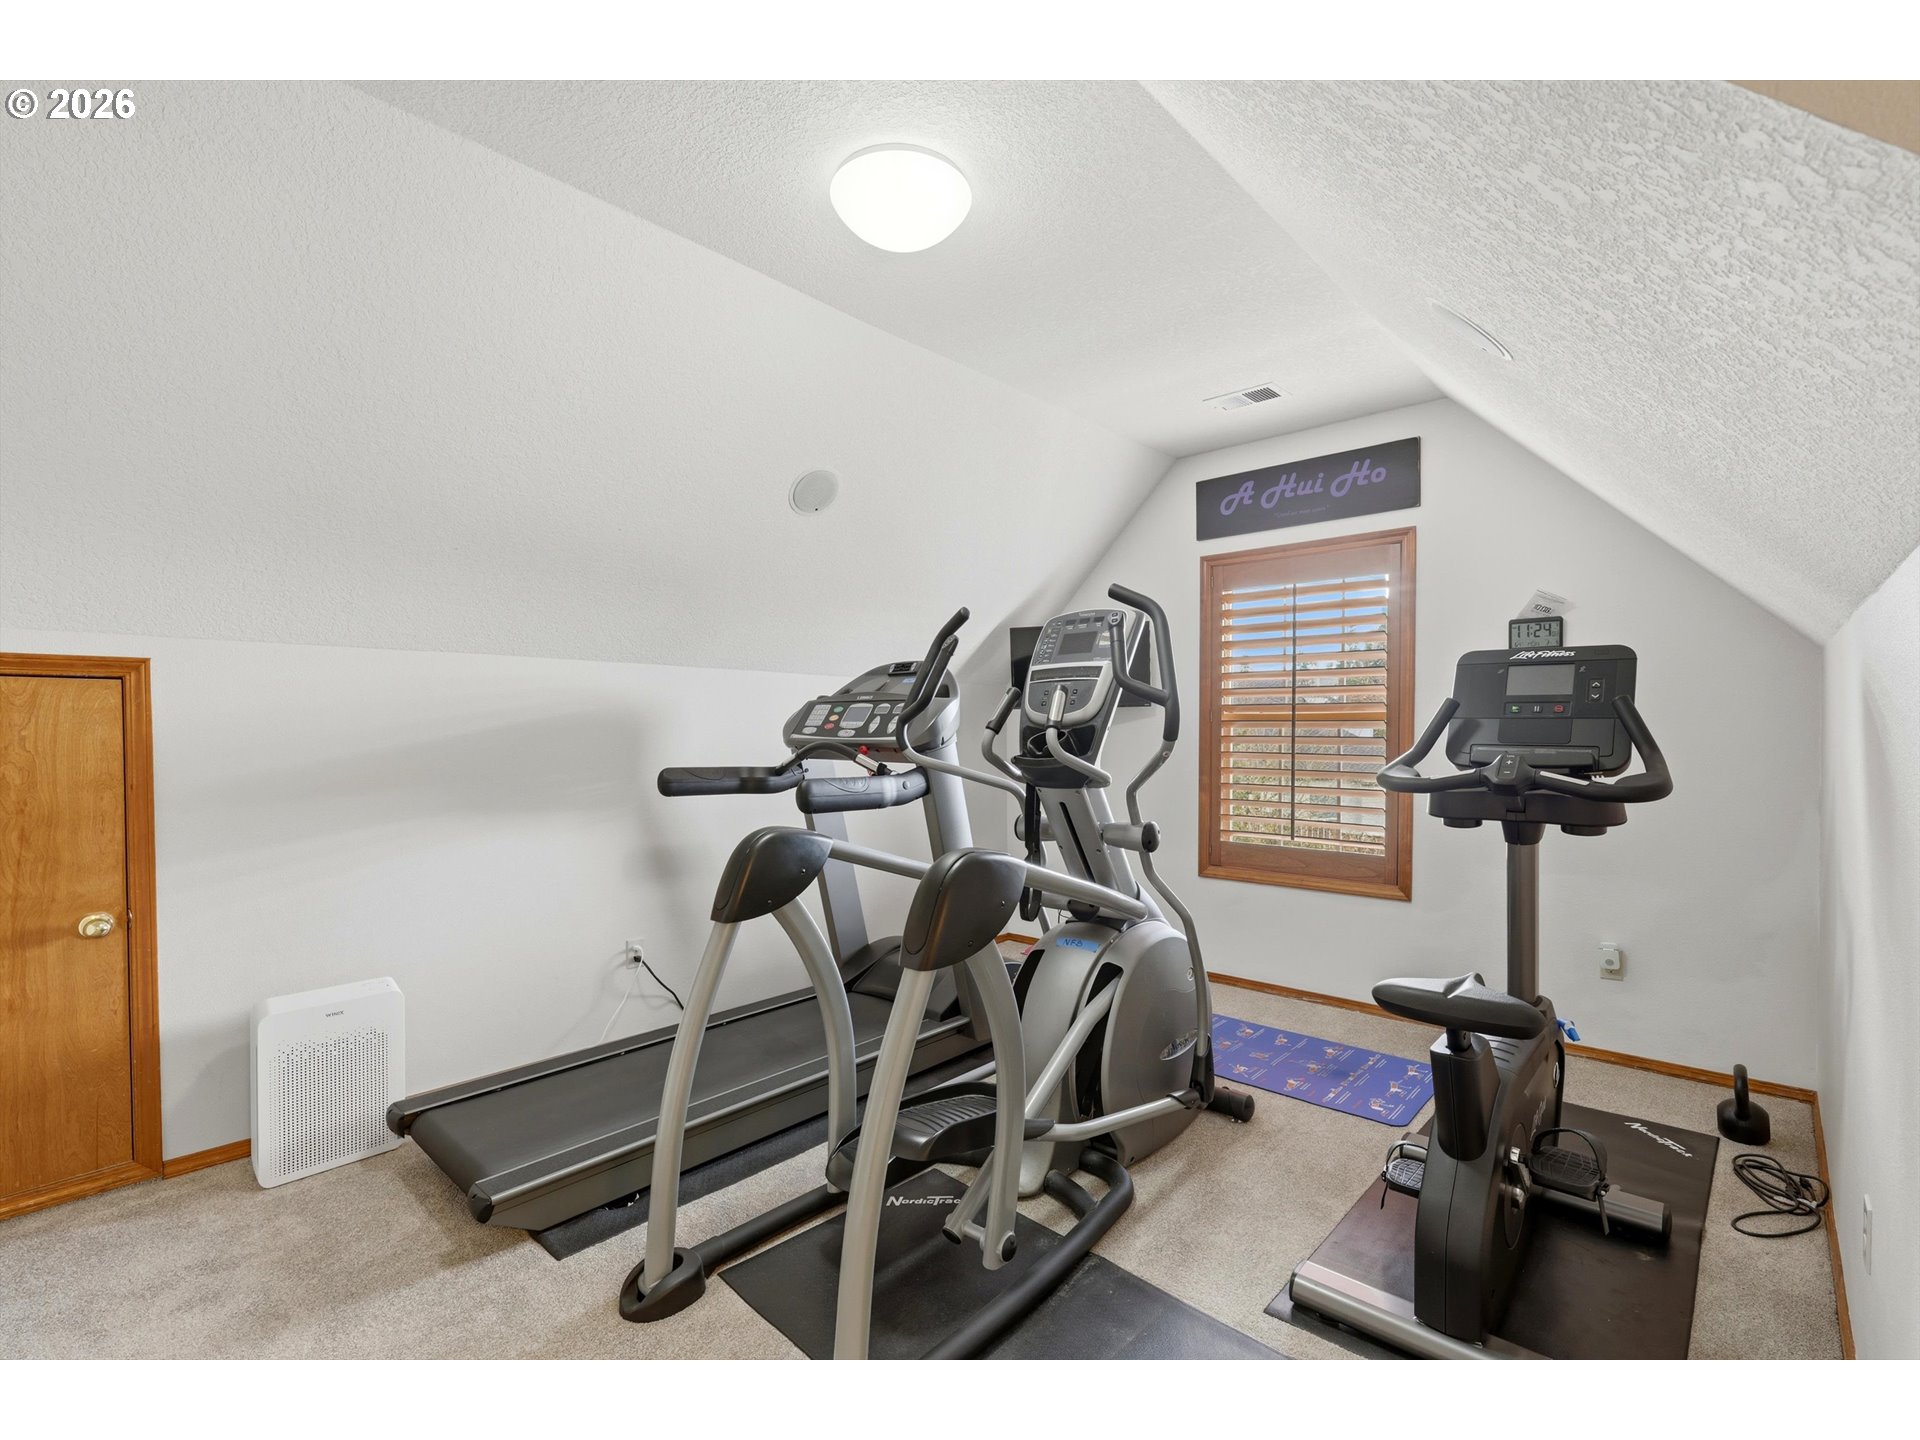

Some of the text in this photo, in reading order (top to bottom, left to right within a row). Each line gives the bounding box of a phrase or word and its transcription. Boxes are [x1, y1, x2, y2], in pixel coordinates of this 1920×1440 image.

[1219, 458, 1387, 516] A Hui Ho
[1517, 623, 1552, 638] 11:24
[886, 1195, 961, 1207] NordicTrac
